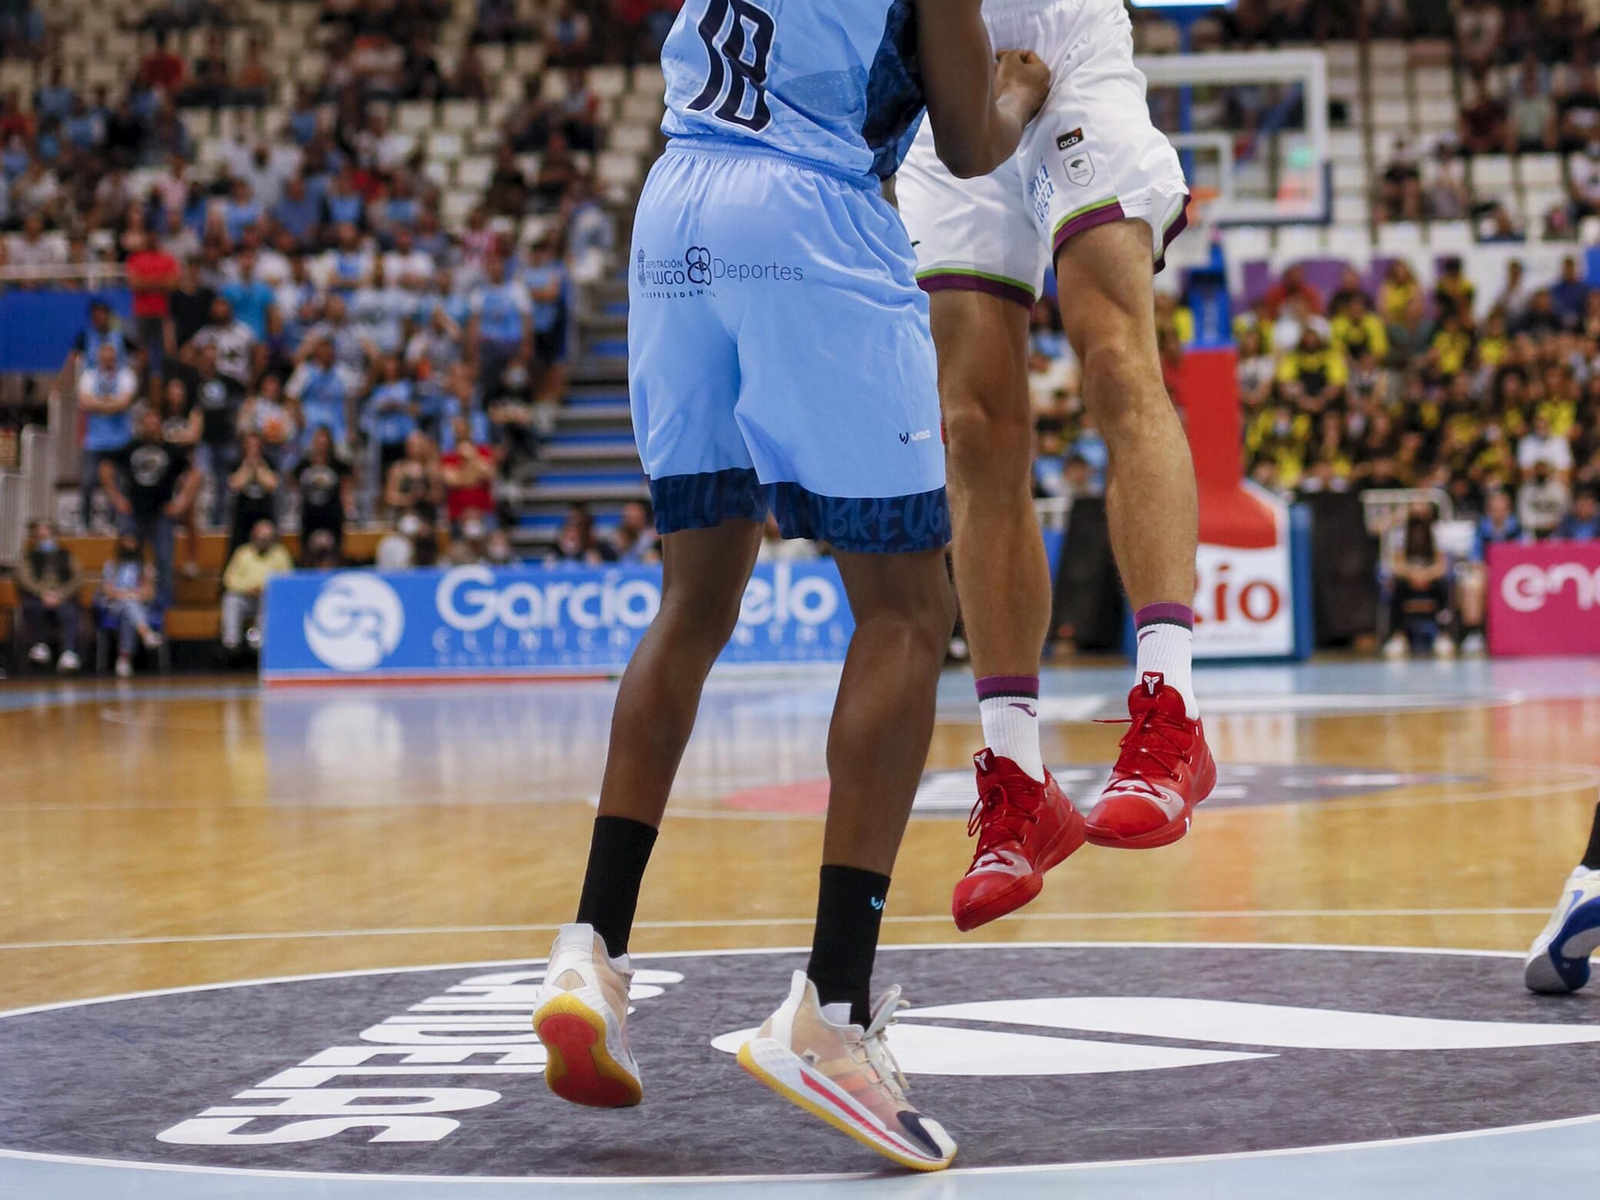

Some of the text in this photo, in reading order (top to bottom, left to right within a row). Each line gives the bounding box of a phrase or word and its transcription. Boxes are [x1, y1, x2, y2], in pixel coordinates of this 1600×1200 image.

[1059, 135, 1079, 148] acb
[653, 270, 685, 285] LUGO
[713, 258, 804, 283] Deportes
[737, 561, 838, 626] elo
